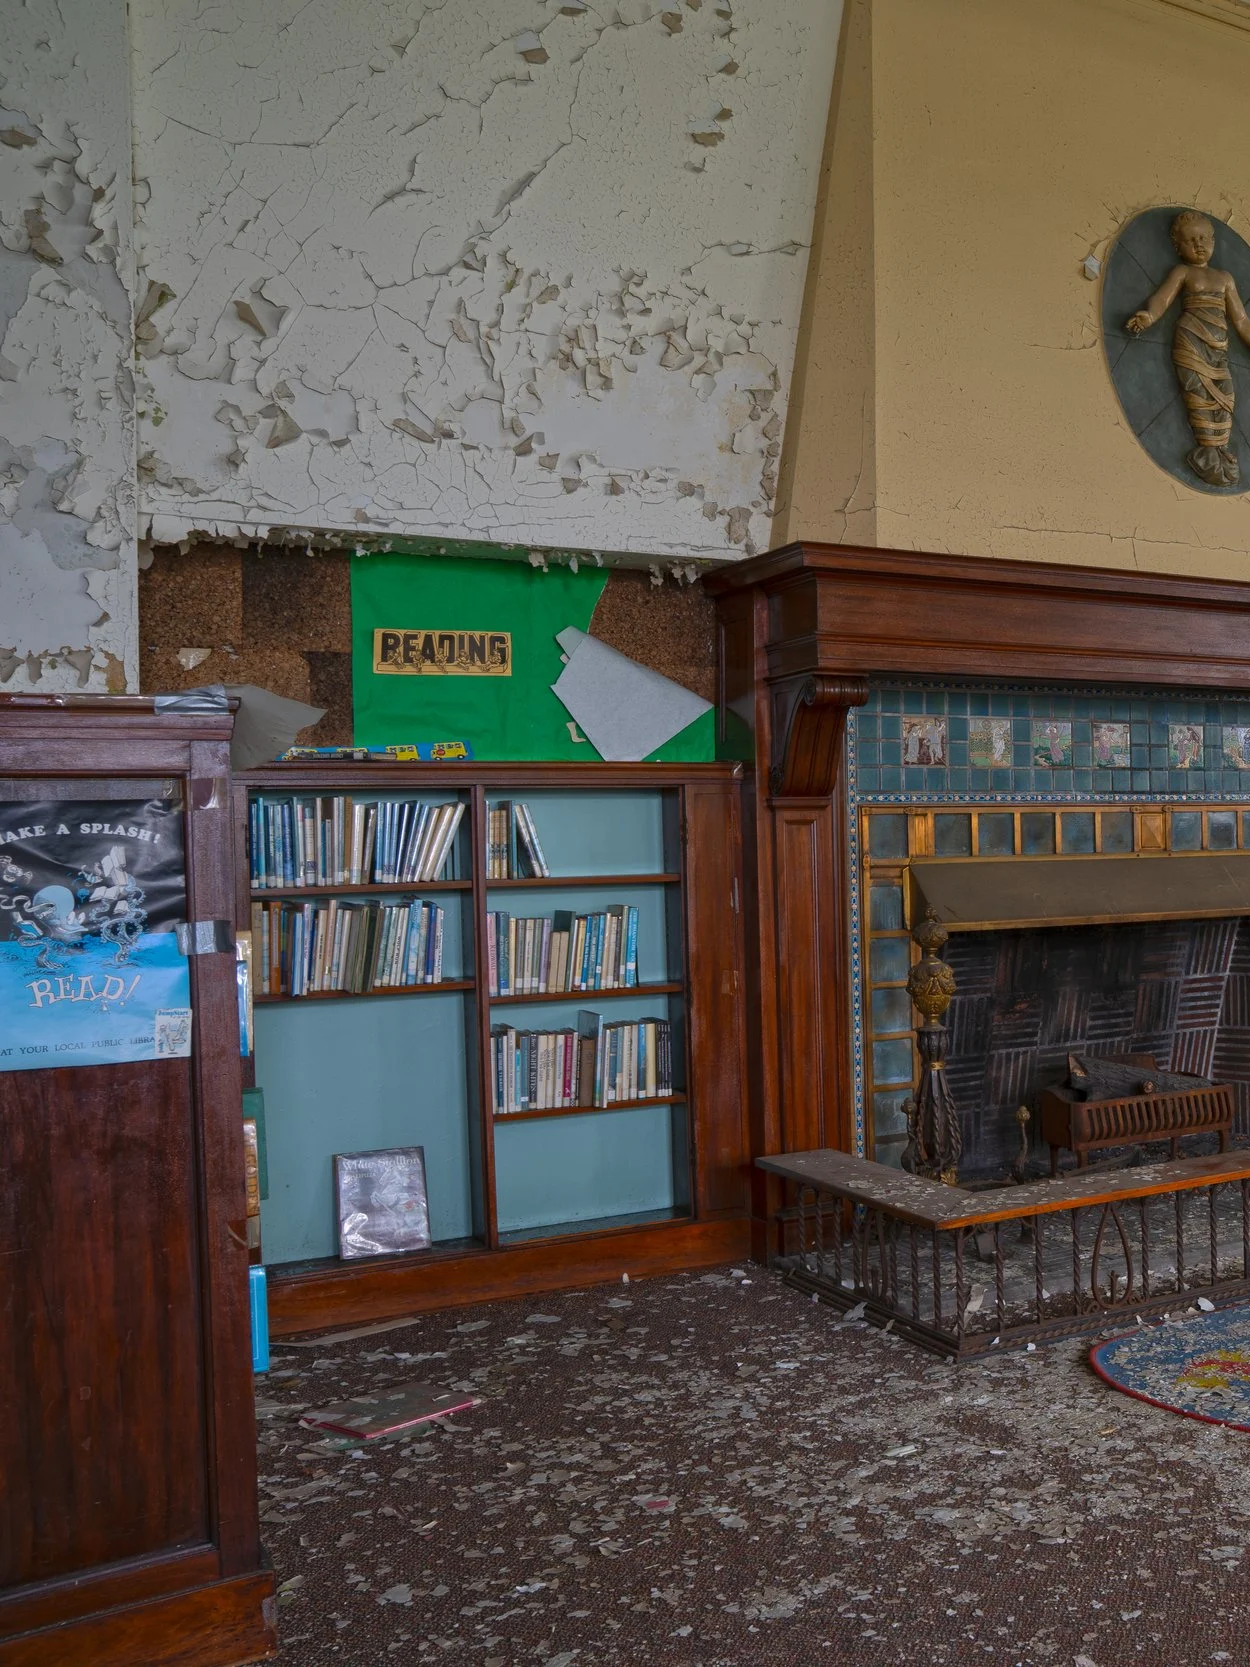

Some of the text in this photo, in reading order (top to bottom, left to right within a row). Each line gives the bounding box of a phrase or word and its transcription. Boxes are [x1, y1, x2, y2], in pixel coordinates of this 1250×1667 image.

[381, 632, 507, 664] READING
[56, 824, 70, 835] A
[80, 823, 161, 844] SPLASH!
[25, 974, 141, 1008] READ!
[0, 1036, 155, 1056] AT YOUR LOCAL PUBLIC LIBRA
[342, 1155, 420, 1170] White Stallion
[246, 1153, 260, 1213] GOLDEN
